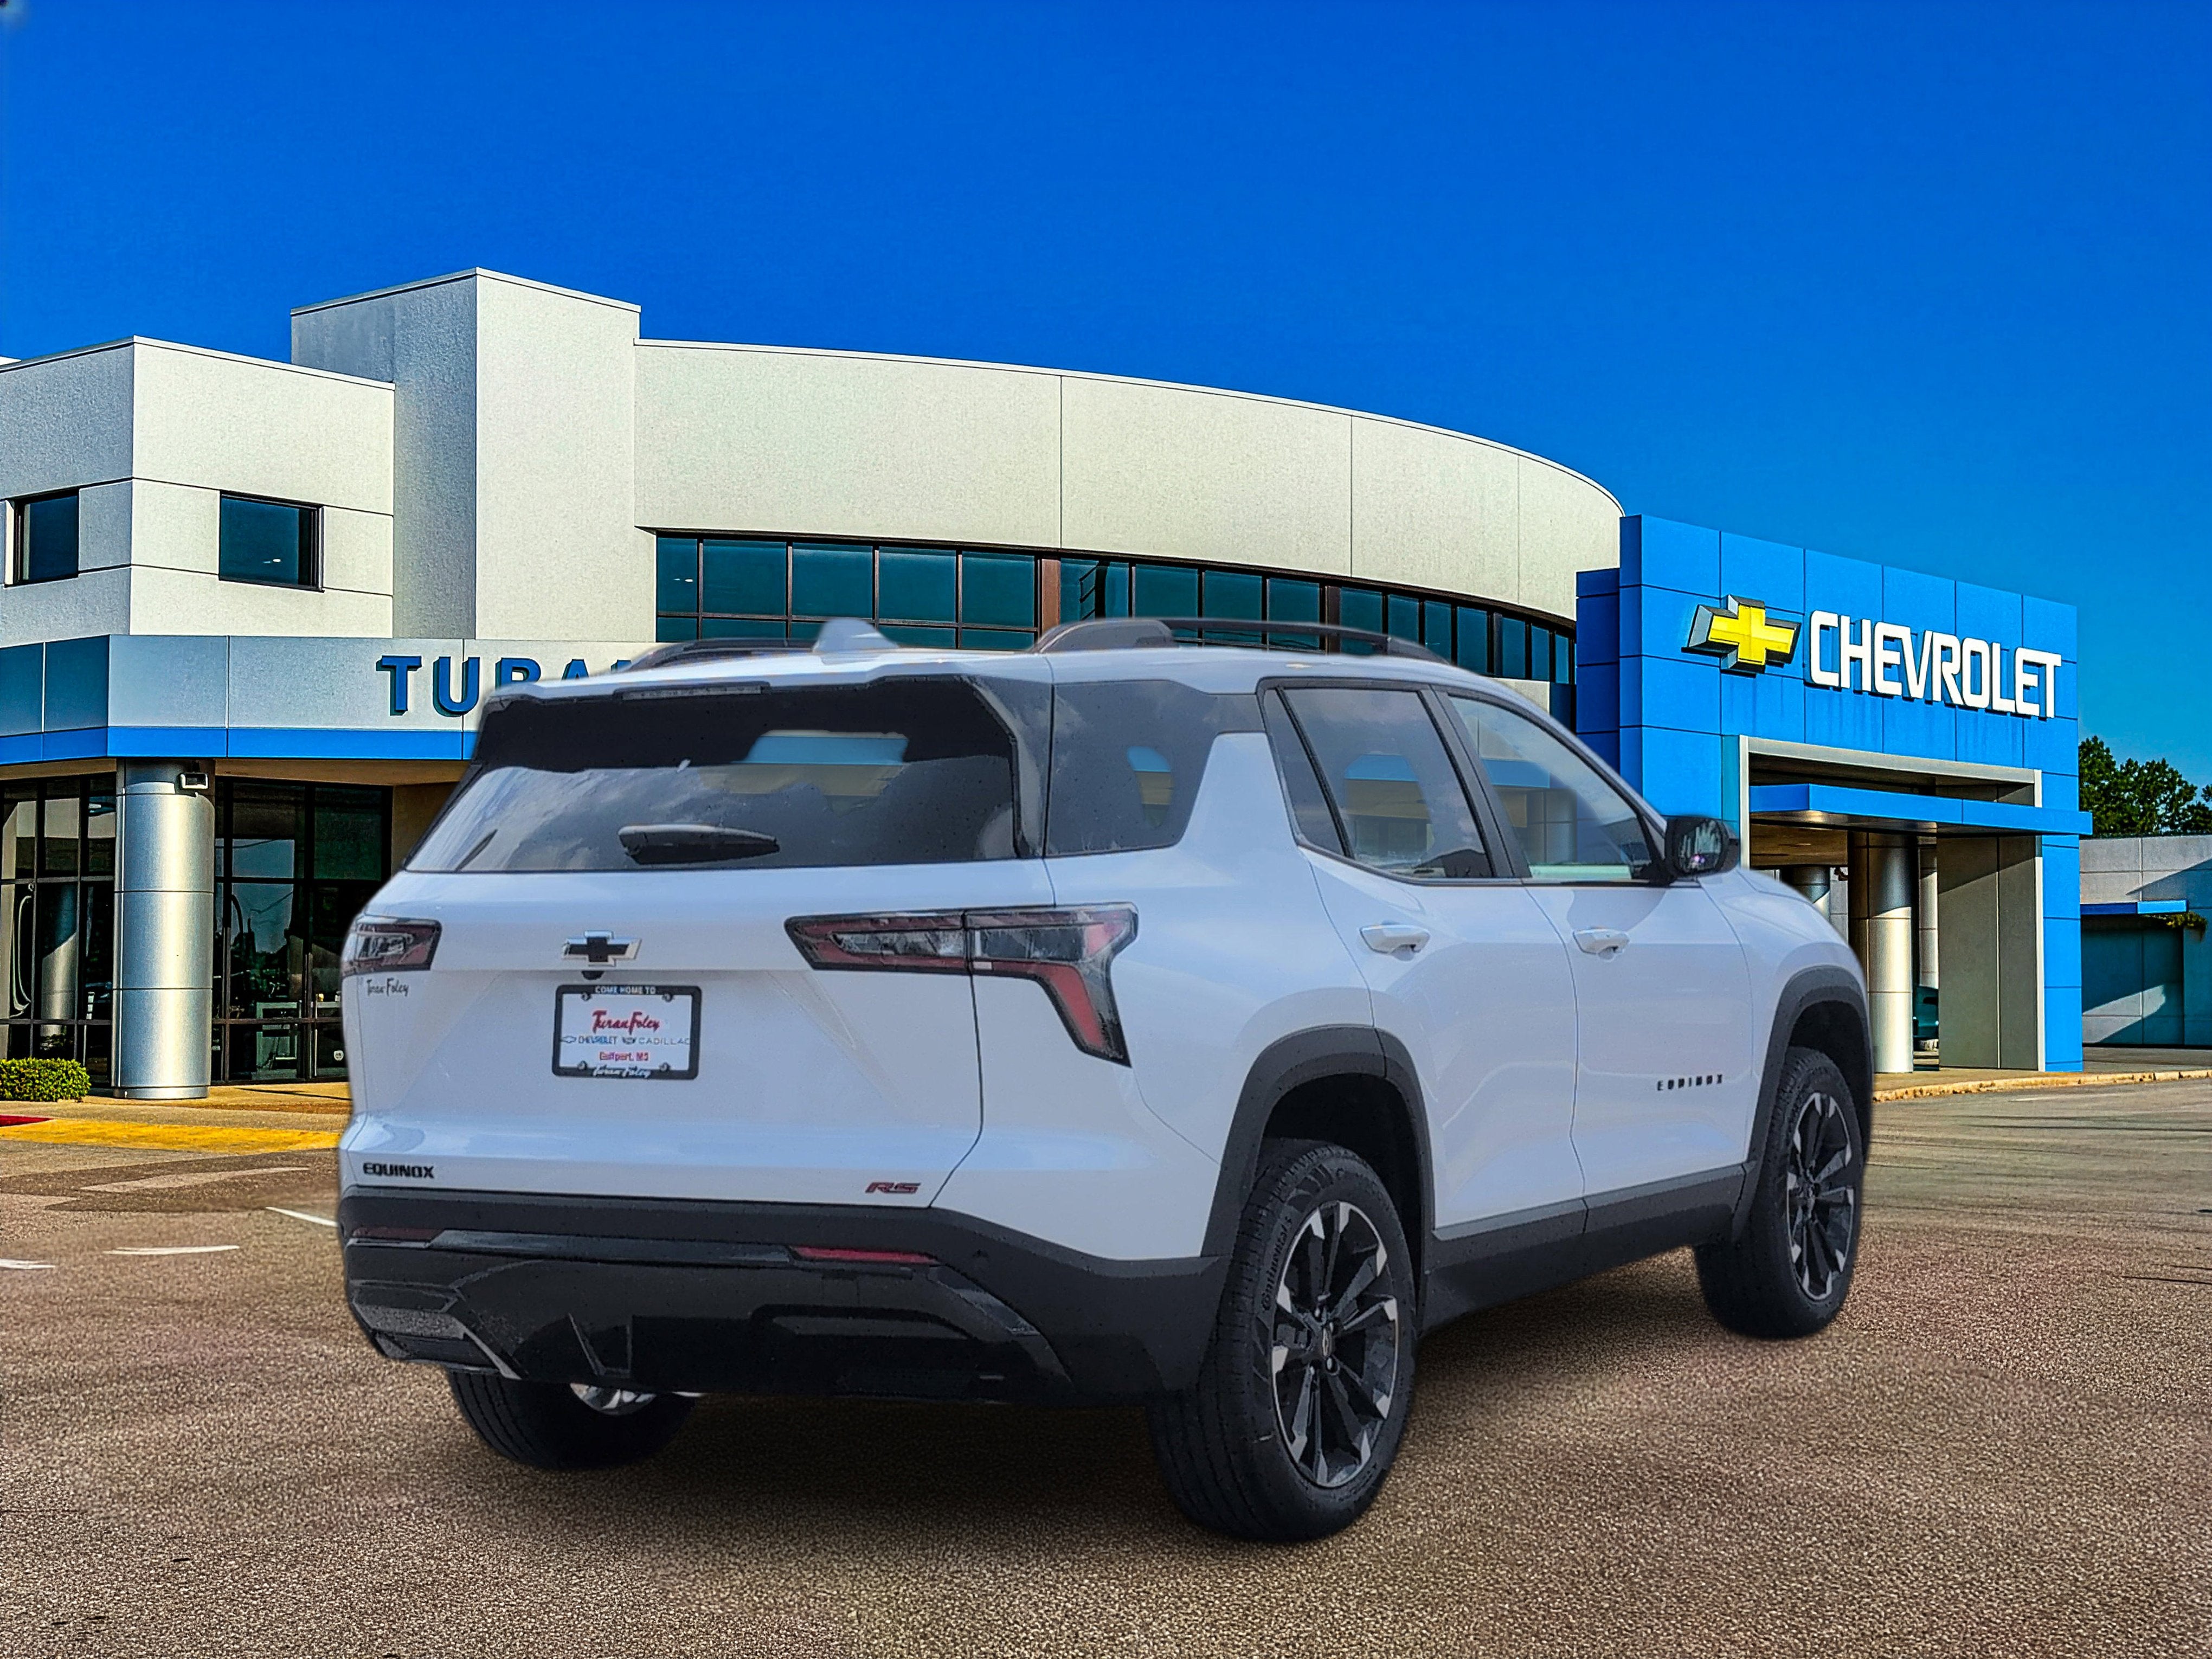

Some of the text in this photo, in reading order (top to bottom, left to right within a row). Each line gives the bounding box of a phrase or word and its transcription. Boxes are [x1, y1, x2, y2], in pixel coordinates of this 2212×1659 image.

[1810, 610, 2062, 718] CHEVROLET
[595, 986, 657, 995] COME HOME TO
[578, 1036, 690, 1045] CHEVROLET CADILLAC
[636, 1052, 648, 1062] MS
[1657, 1073, 1722, 1091] EQUINOX
[362, 1162, 435, 1179] EQUINOX
[865, 1181, 921, 1194] RS
